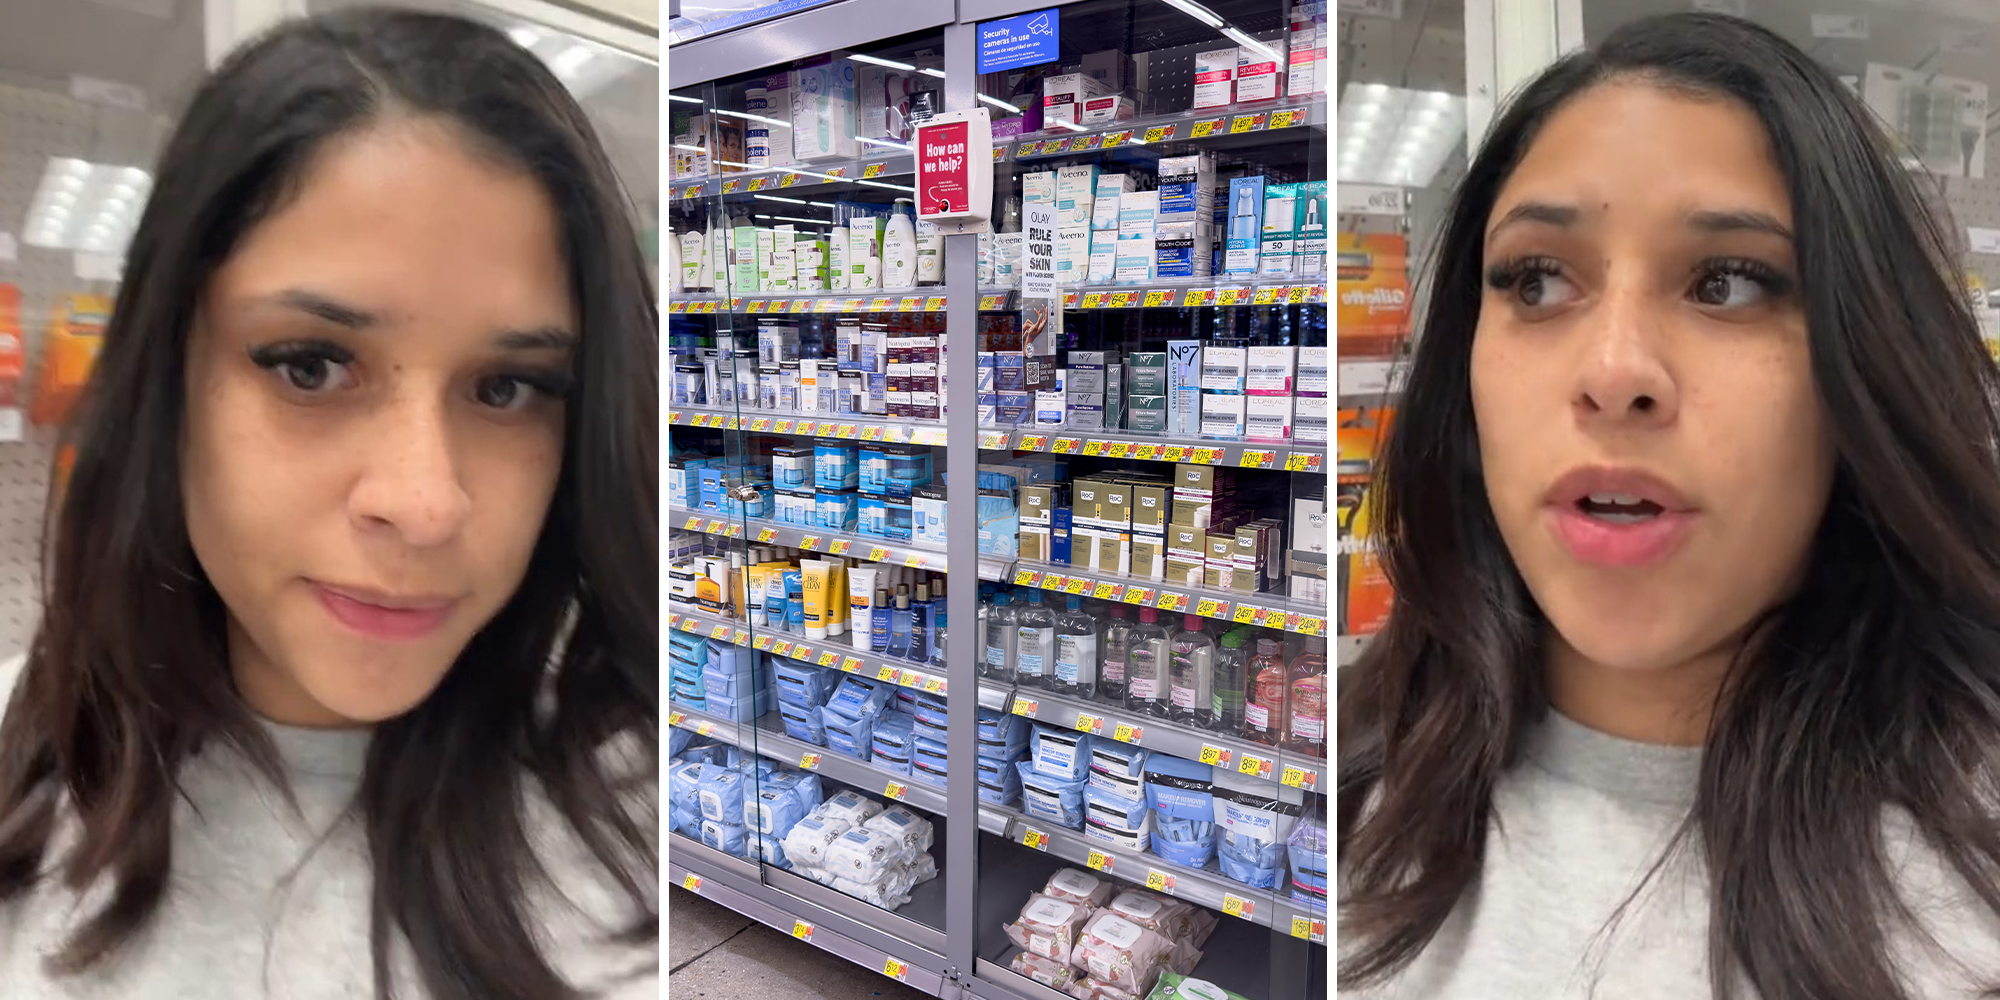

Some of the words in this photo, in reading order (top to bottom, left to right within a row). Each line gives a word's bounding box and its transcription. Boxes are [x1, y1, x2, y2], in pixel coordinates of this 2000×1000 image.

[744, 9, 771, 22] obtener
[983, 28, 1010, 39] Security
[983, 38, 1010, 48] cameras
[1011, 35, 1018, 43] in
[1018, 34, 1030, 42] use
[1007, 44, 1027, 53] seguridad
[926, 143, 945, 157] How
[947, 142, 965, 155] can
[924, 162, 937, 173] we
[938, 156, 963, 173] help?
[1059, 169, 1089, 179] Aveeno
[1266, 186, 1296, 194] L'ORÉAL
[1030, 211, 1050, 225] OLAY
[851, 222, 874, 231] Aveeno
[1029, 227, 1052, 242] RULE
[1058, 231, 1085, 241] Aveeno
[1029, 242, 1053, 257] YOUR
[1271, 242, 1283, 250] 50
[1029, 257, 1052, 271] SKIN
[1253, 348, 1287, 356] L'ORÉAL
[1252, 397, 1286, 405] L'ORÉAL
[1243, 452, 1260, 465] 1012
[1187, 472, 1201, 480] RoC
[920, 490, 942, 498] Neutrogena
[1109, 495, 1122, 503] RoC
[1180, 533, 1193, 541] RoC
[1238, 537, 1252, 546] RoC
[802, 582, 821, 590] CLEAN
[700, 599, 717, 607] Neutrogena
[1235, 607, 1253, 619] 2497
[1266, 614, 1285, 625] 2197
[1077, 717, 1092, 728] 897
[1202, 748, 1218, 759] 897
[1241, 758, 1258, 770] 897
[1284, 771, 1301, 782] 1197
[1157, 792, 1179, 801] MAKEUP
[1180, 796, 1206, 807] REMOVER
[1025, 832, 1038, 843] 567
[1089, 853, 1104, 865] 1027
[1149, 872, 1163, 885] 688
[1226, 897, 1240, 910] 687
[794, 924, 805, 933] 374
[886, 960, 898, 970] 612
